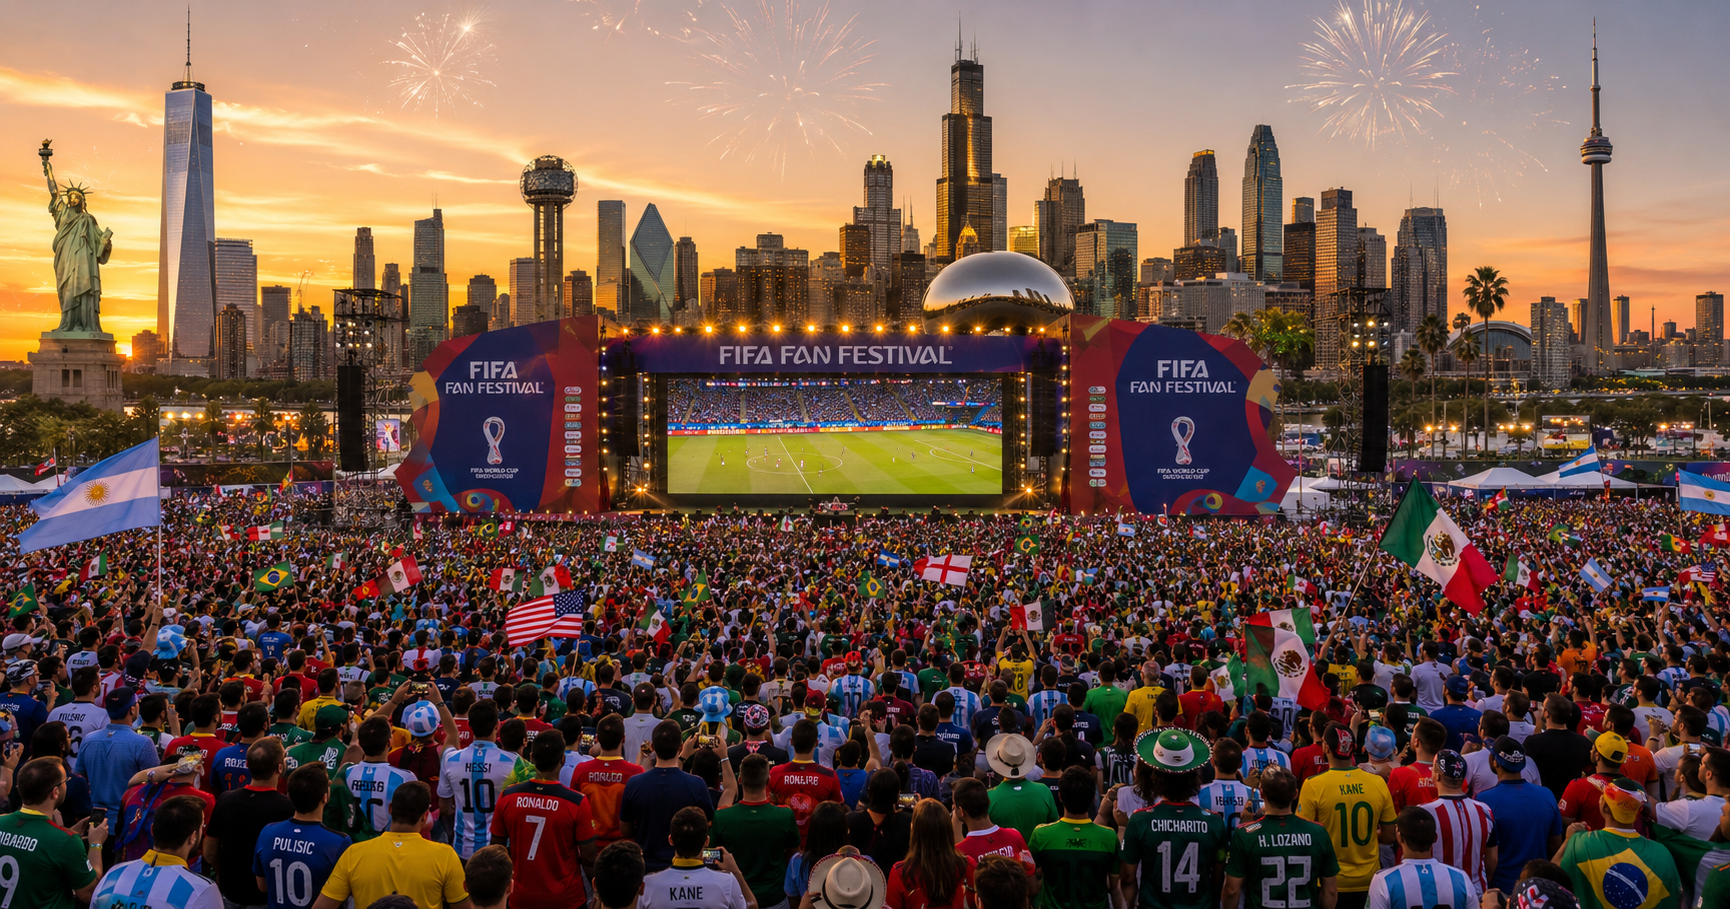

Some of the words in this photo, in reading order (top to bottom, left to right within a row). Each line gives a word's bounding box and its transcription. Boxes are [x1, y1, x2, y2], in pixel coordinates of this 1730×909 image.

[719, 345, 773, 365] FIFA
[780, 345, 831, 365] FAN
[838, 345, 953, 365] FESTIVAL
[469, 361, 519, 380] FIFA
[1157, 360, 1209, 379] FIFA
[445, 382, 474, 394] FAN
[477, 382, 544, 394] FESTIVAL
[1130, 381, 1161, 393] FAN
[1165, 381, 1236, 393] FESTIVAL
[459, 778, 495, 814] 10
[1338, 783, 1365, 796] KANE
[516, 796, 560, 812] RONALDO
[1151, 819, 1208, 834] CHICHARITO
[1334, 801, 1374, 848] 10
[272, 837, 315, 855] PULISIC
[525, 815, 547, 861] 7
[1258, 834, 1270, 847] H.
[1271, 833, 1312, 847] LOZANO
[1157, 840, 1200, 893] 14
[0, 855, 20, 909] 9
[269, 858, 313, 907] 10
[1260, 855, 1312, 909] 22
[670, 886, 704, 901] KANE
